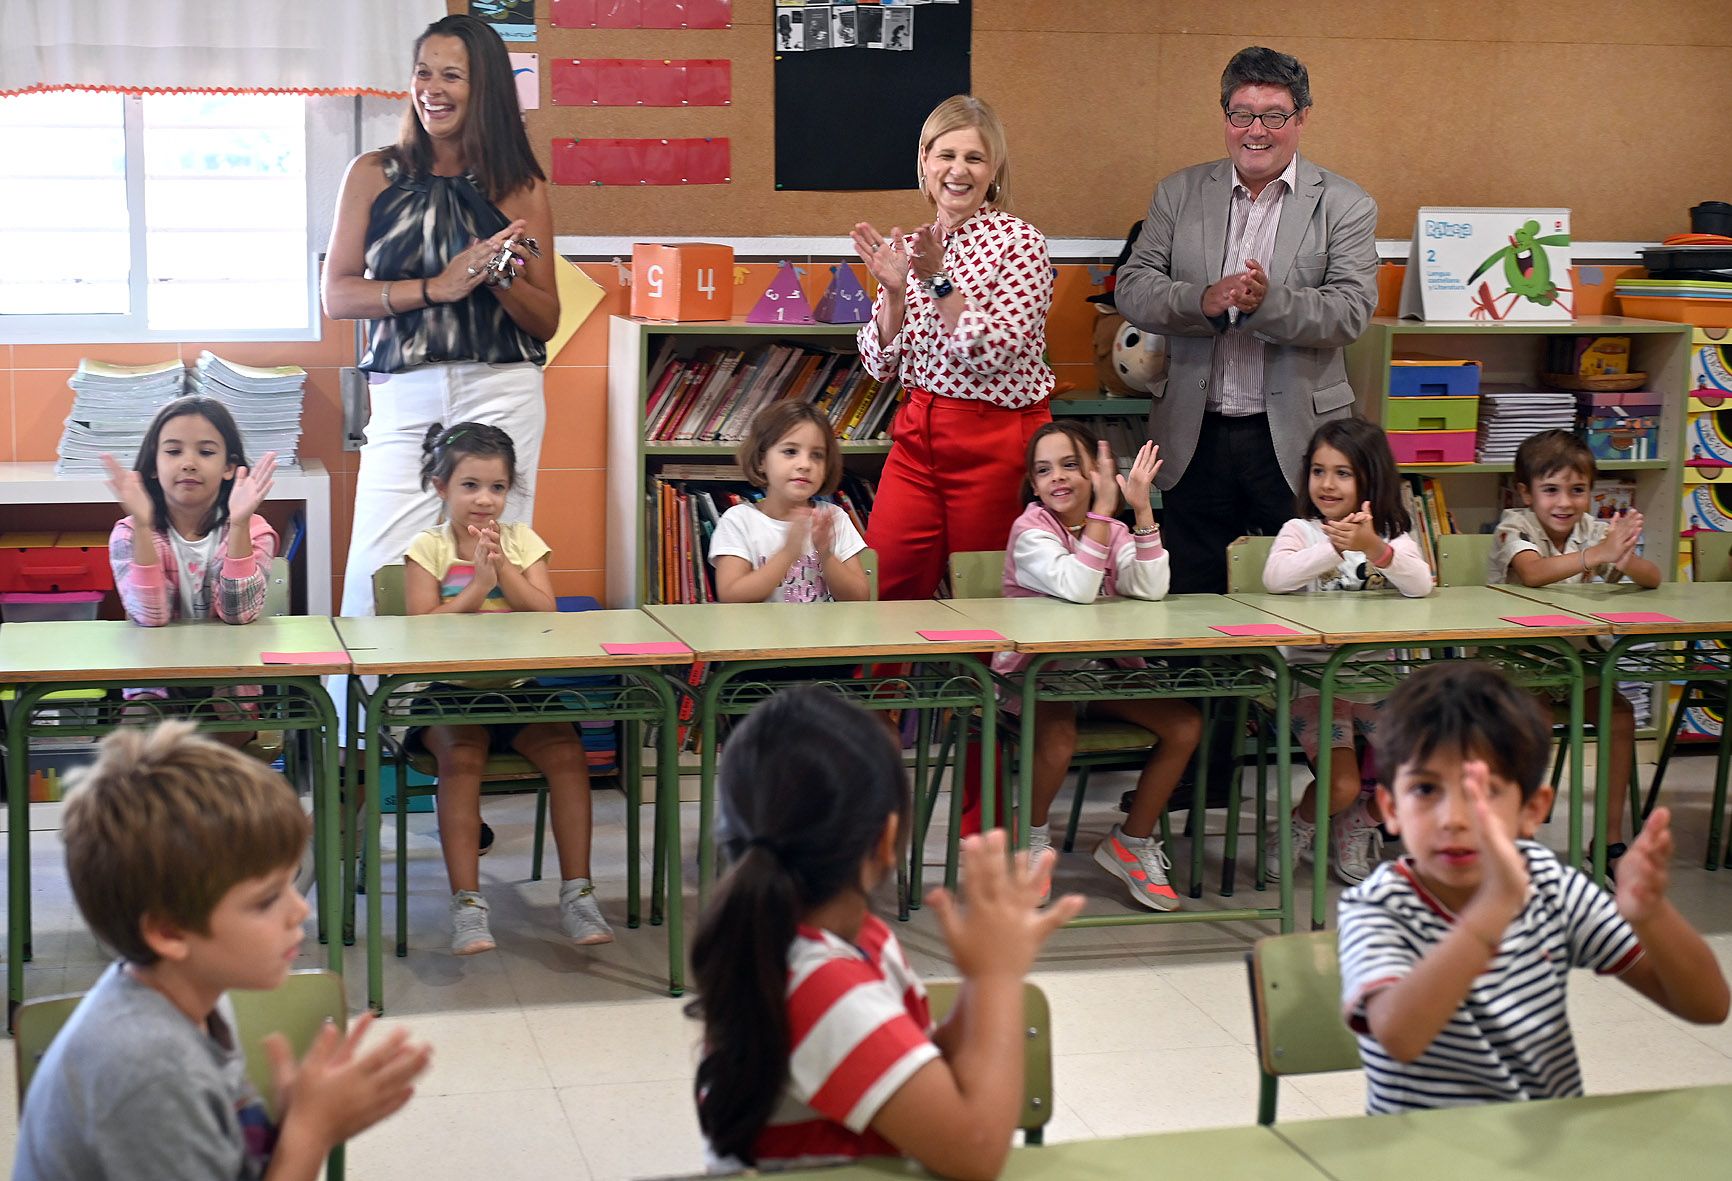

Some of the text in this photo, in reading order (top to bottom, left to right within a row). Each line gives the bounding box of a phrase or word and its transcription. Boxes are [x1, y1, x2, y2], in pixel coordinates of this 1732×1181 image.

[1426, 249, 1436, 262] 2
[647, 264, 664, 298] 5
[697, 268, 716, 300] 4
[776, 307, 785, 321] 1
